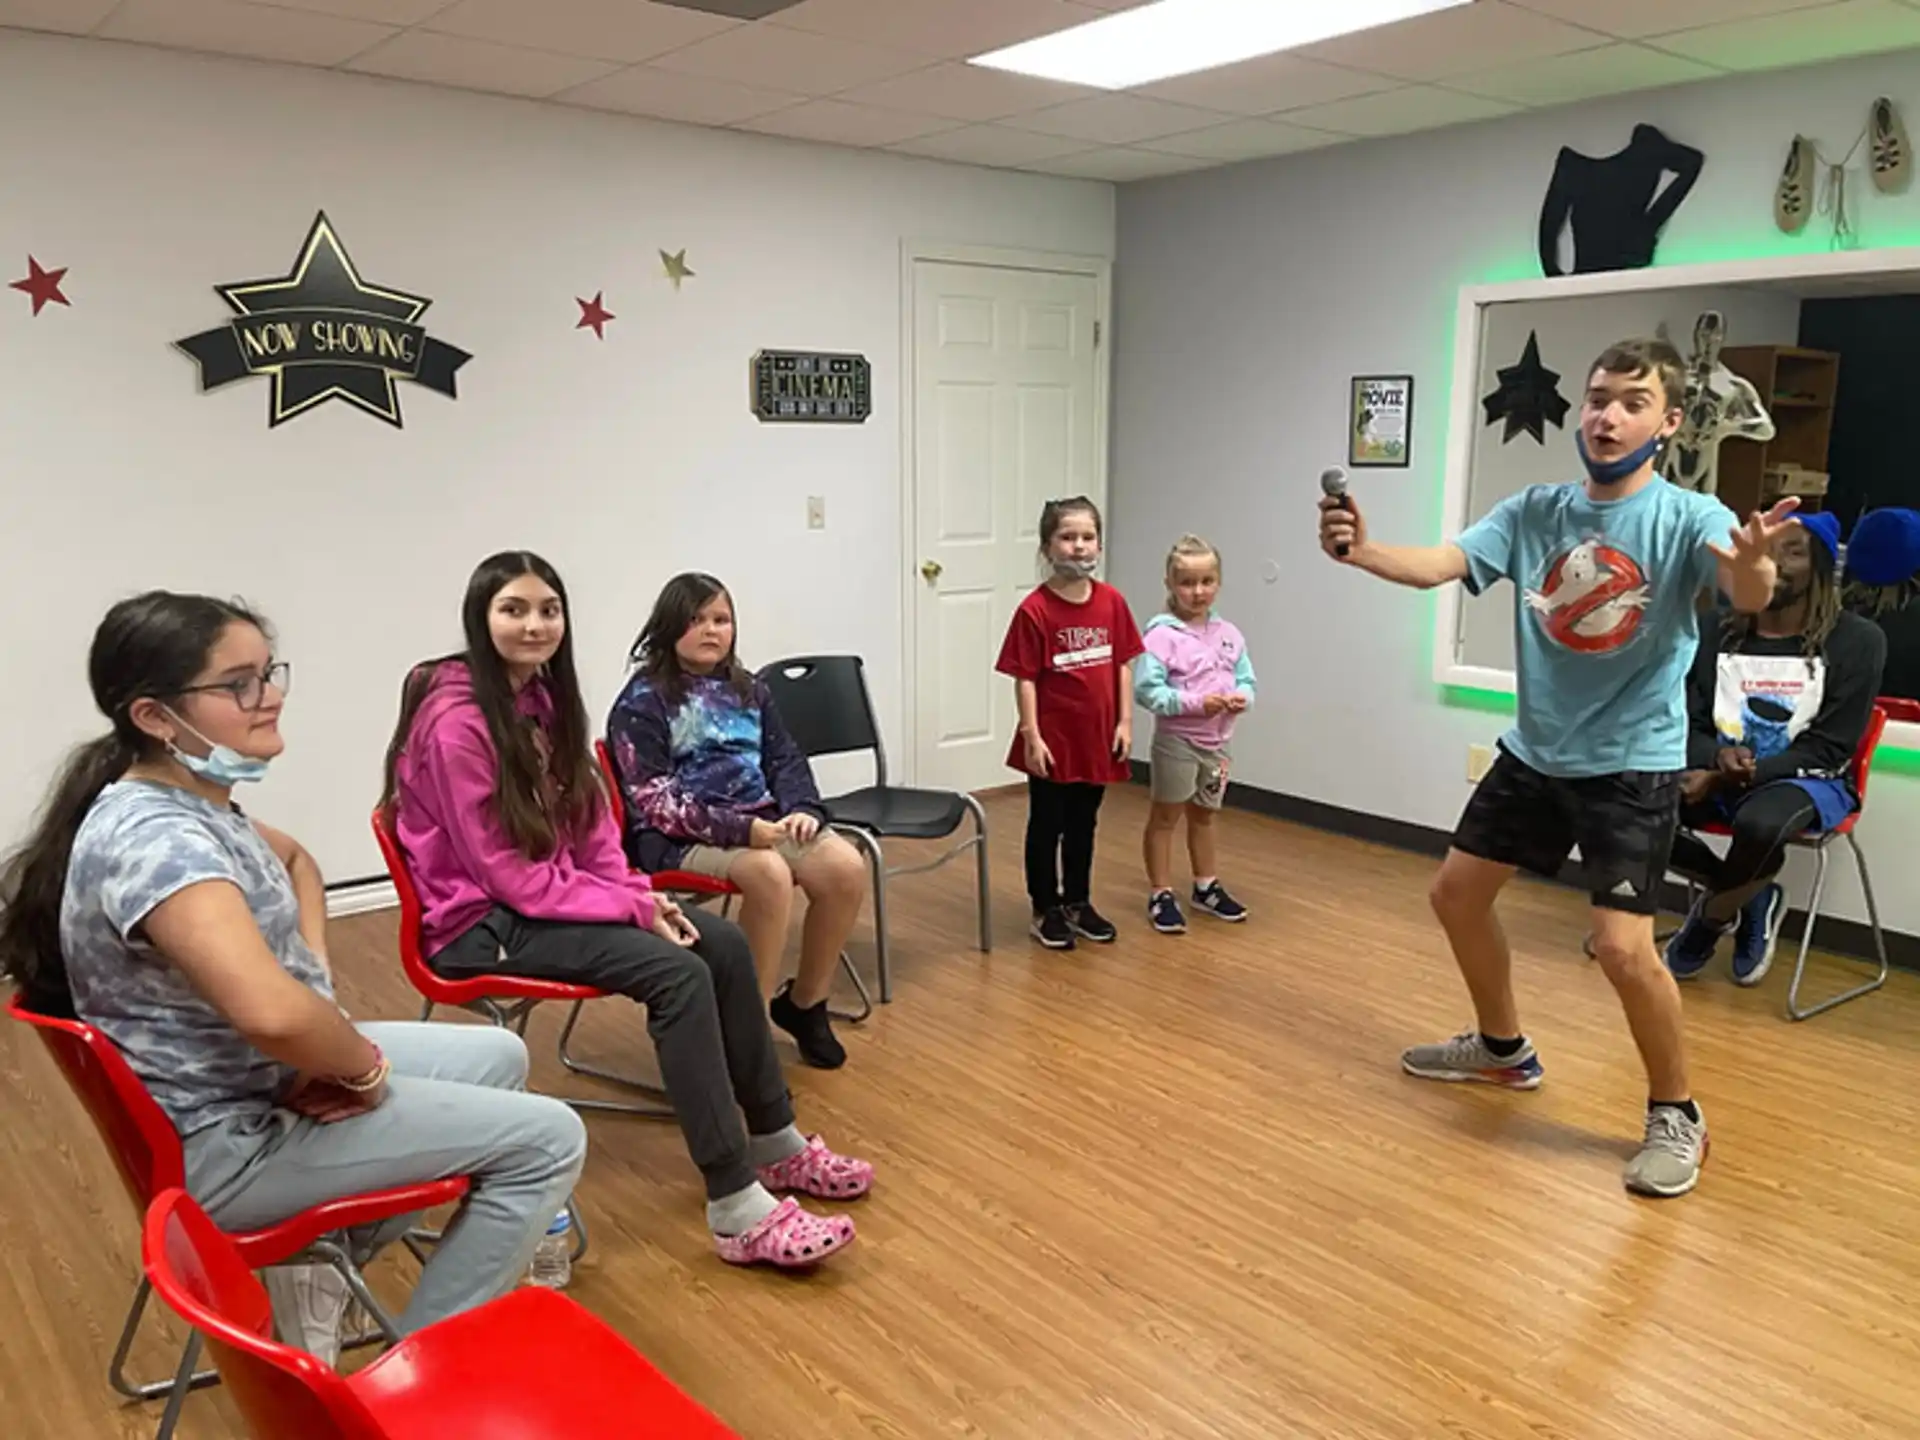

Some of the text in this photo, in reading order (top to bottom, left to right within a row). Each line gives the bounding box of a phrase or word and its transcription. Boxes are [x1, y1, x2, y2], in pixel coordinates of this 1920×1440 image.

[244, 319, 416, 363] NOW SHOWING
[773, 372, 854, 399] CINEMA
